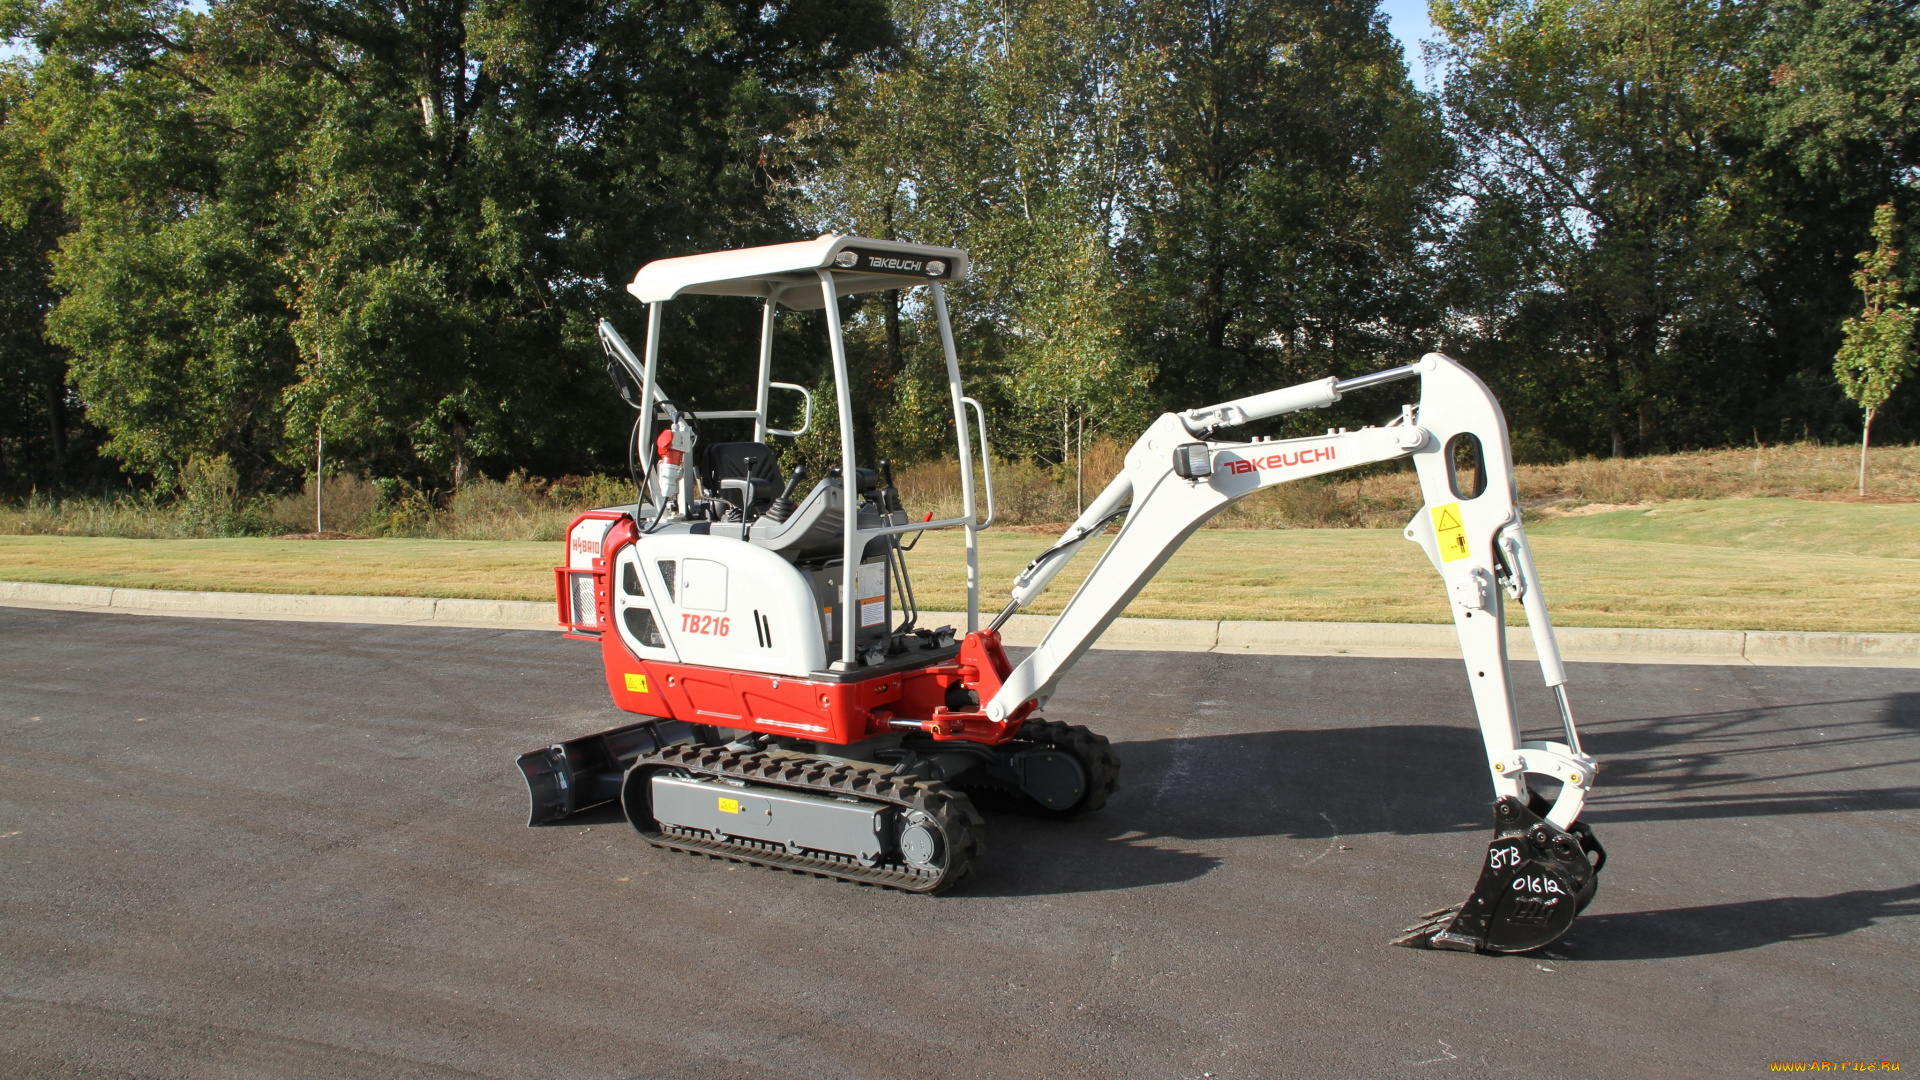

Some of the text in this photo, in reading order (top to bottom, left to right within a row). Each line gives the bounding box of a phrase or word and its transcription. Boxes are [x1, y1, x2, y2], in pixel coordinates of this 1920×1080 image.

[868, 256, 922, 271] TAKEUCHI
[1224, 446, 1336, 475] TAKEUCHI
[572, 537, 600, 554] HYBRID
[681, 613, 730, 637] TB216
[1490, 846, 1521, 868] BTB
[1512, 875, 1566, 895] 01612
